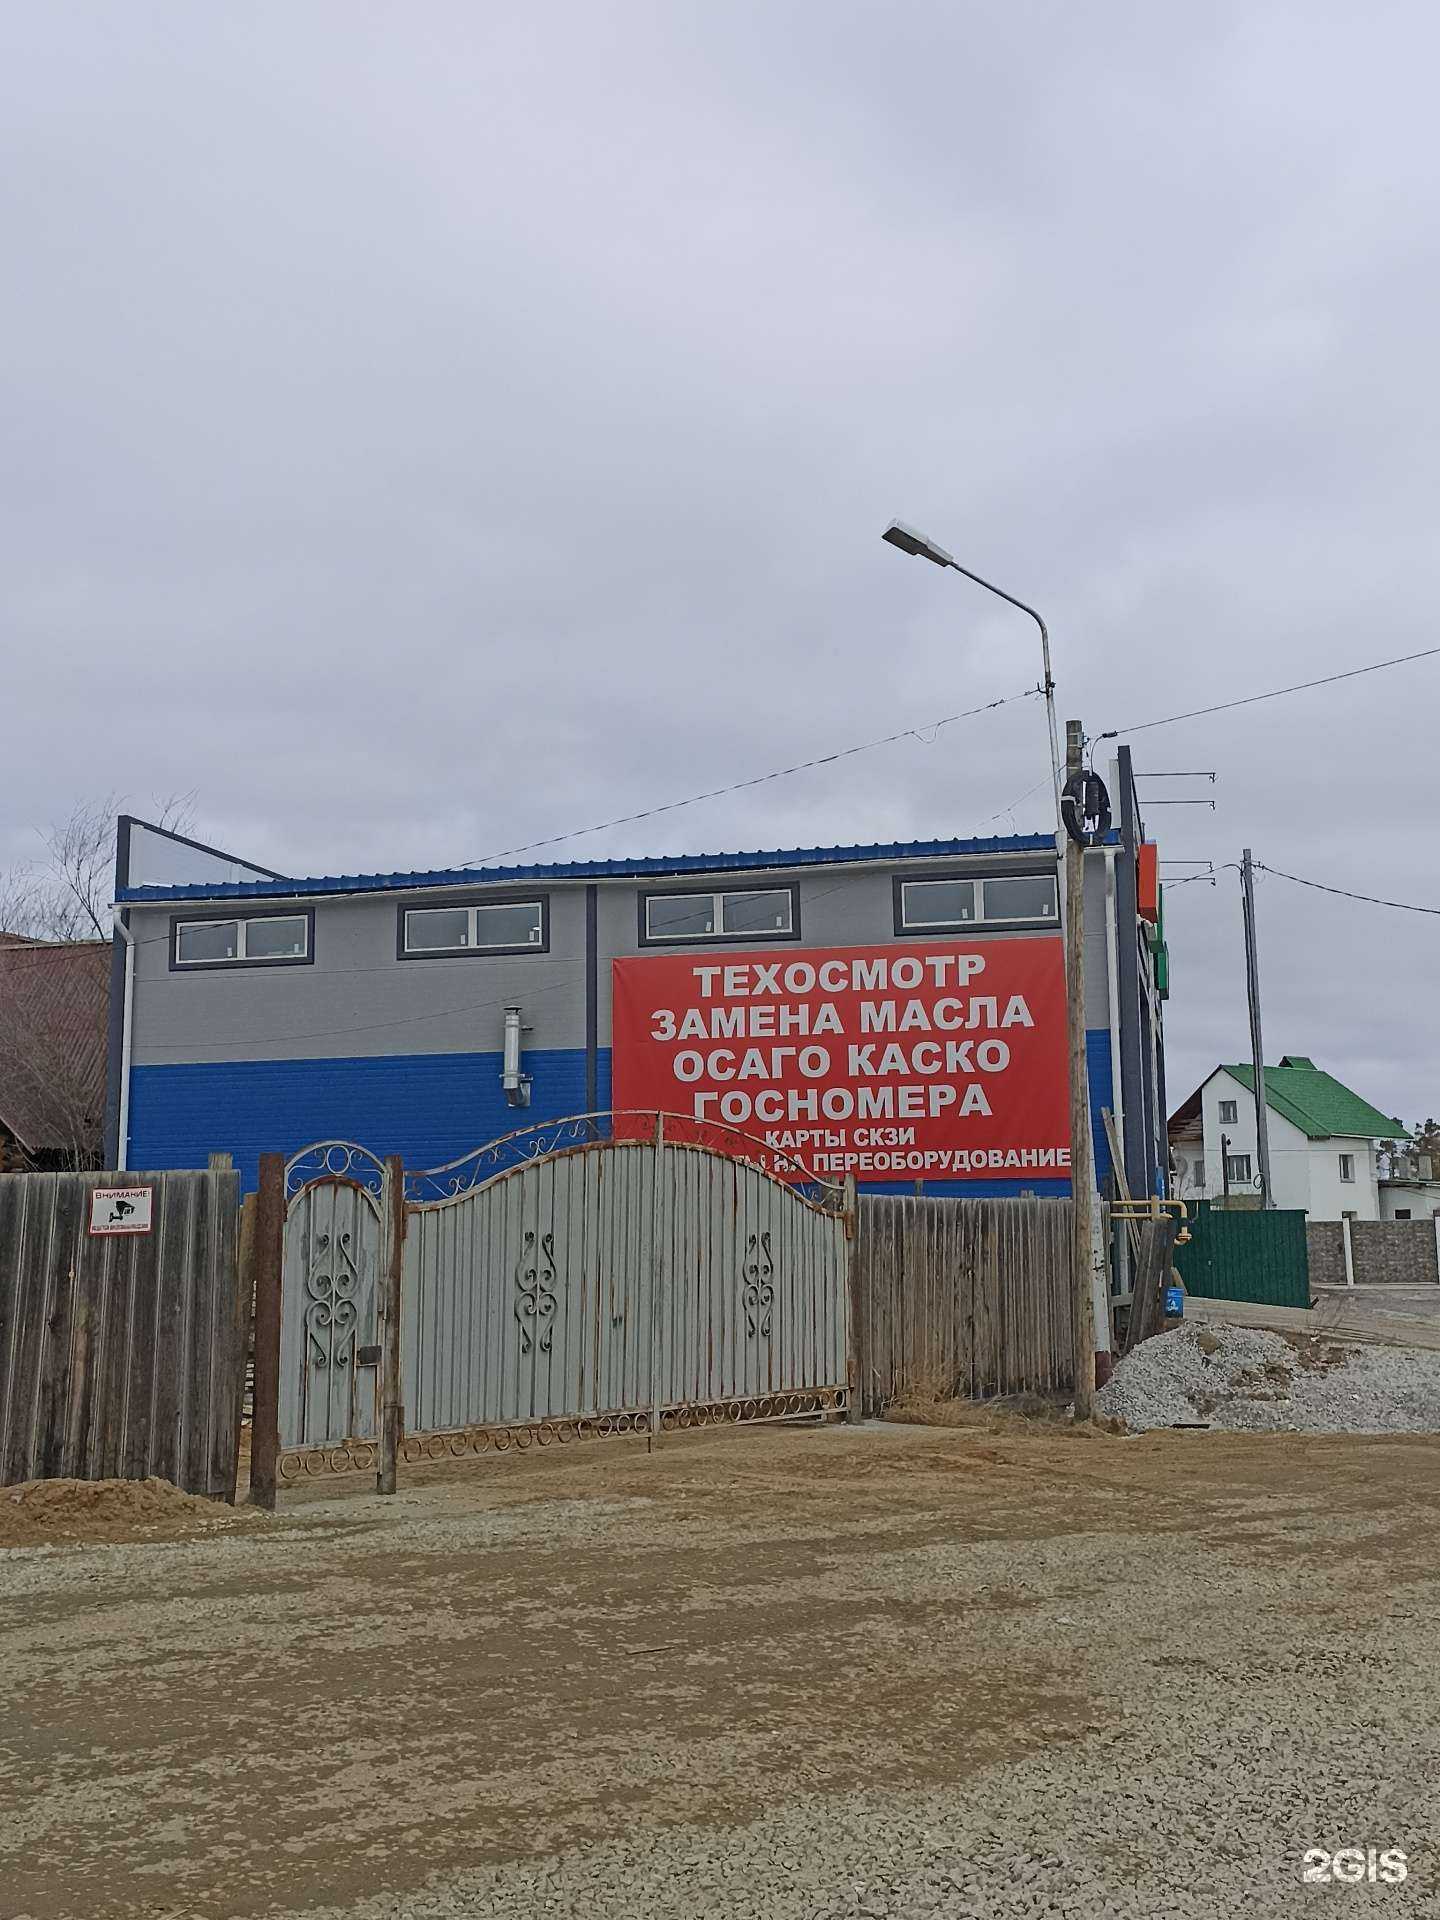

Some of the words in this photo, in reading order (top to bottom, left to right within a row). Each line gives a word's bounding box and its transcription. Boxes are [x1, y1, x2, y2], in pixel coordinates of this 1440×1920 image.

[693, 954, 986, 998] ТЕХОСМОТР
[650, 1002, 845, 1041] ЗАМЕНА
[860, 995, 1035, 1034] МАСЛА
[673, 1046, 832, 1082] ОСАГО
[848, 1039, 1011, 1077] КАСКО
[693, 1083, 993, 1124] ГОСНОМЕРА
[765, 1130, 846, 1149] КАРТЫ
[853, 1127, 915, 1147] СКЗИ
[813, 1148, 1072, 1173] ПЕРЕОБОРУДОВАНИЕ
